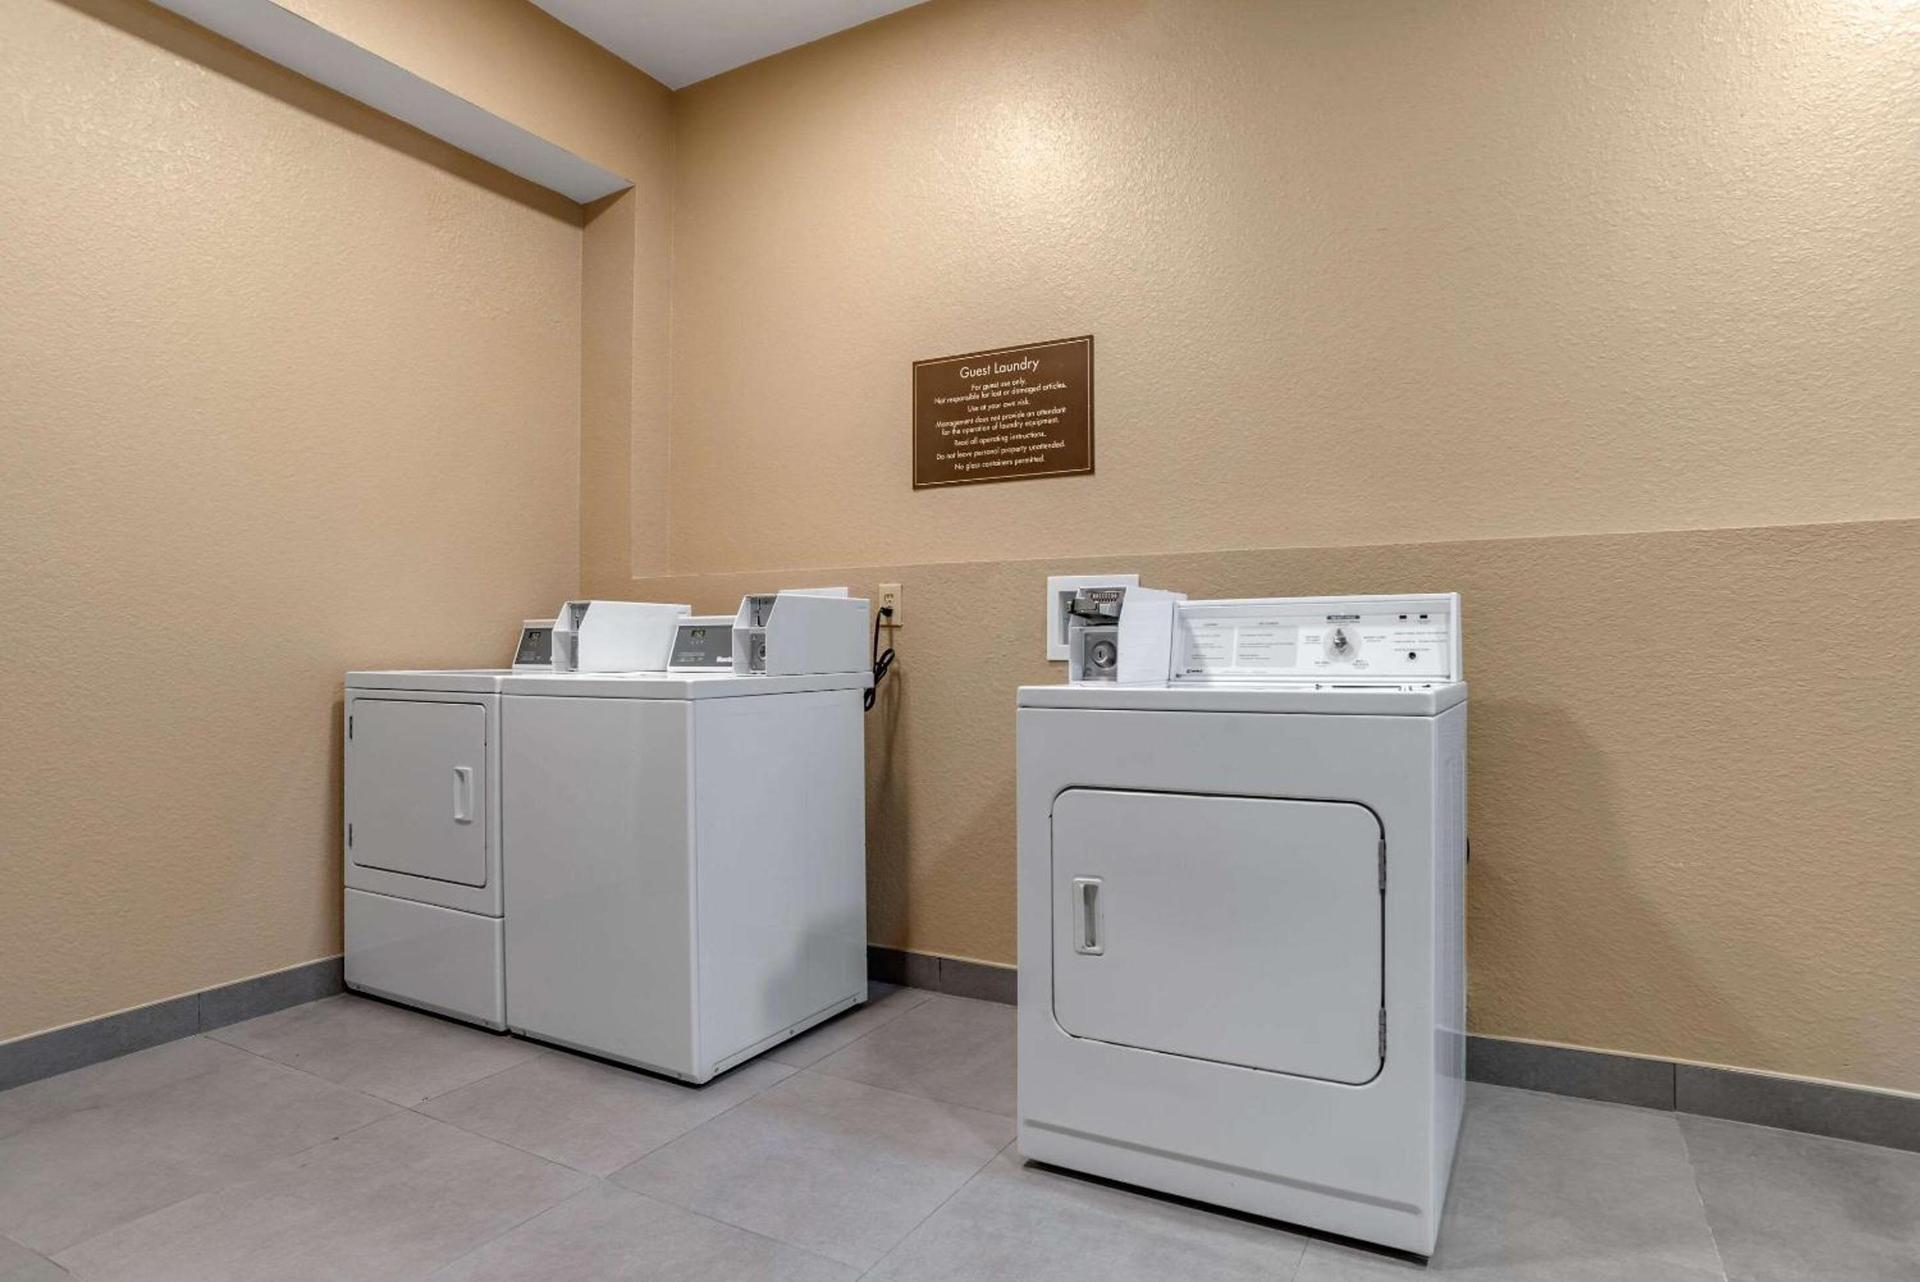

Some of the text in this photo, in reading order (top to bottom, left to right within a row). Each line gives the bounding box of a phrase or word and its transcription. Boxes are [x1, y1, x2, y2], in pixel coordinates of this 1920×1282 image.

[960, 356, 1040, 379] Guest Laundry
[983, 382, 999, 390] guest
[947, 394, 979, 403] responsible
[1011, 384, 1041, 395] damaged
[968, 404, 978, 412] Use
[980, 403, 987, 412] at
[988, 402, 1002, 411] your
[936, 418, 974, 429] Management
[1002, 412, 1025, 421] provide
[952, 427, 961, 435] the
[992, 422, 998, 430] of
[999, 421, 1024, 429] laundry
[979, 435, 1008, 444] operating
[957, 450, 972, 458] leave
[974, 447, 1000, 457] personal
[1001, 445, 1027, 454] property
[966, 462, 980, 471] glass
[982, 459, 1013, 468] containers
